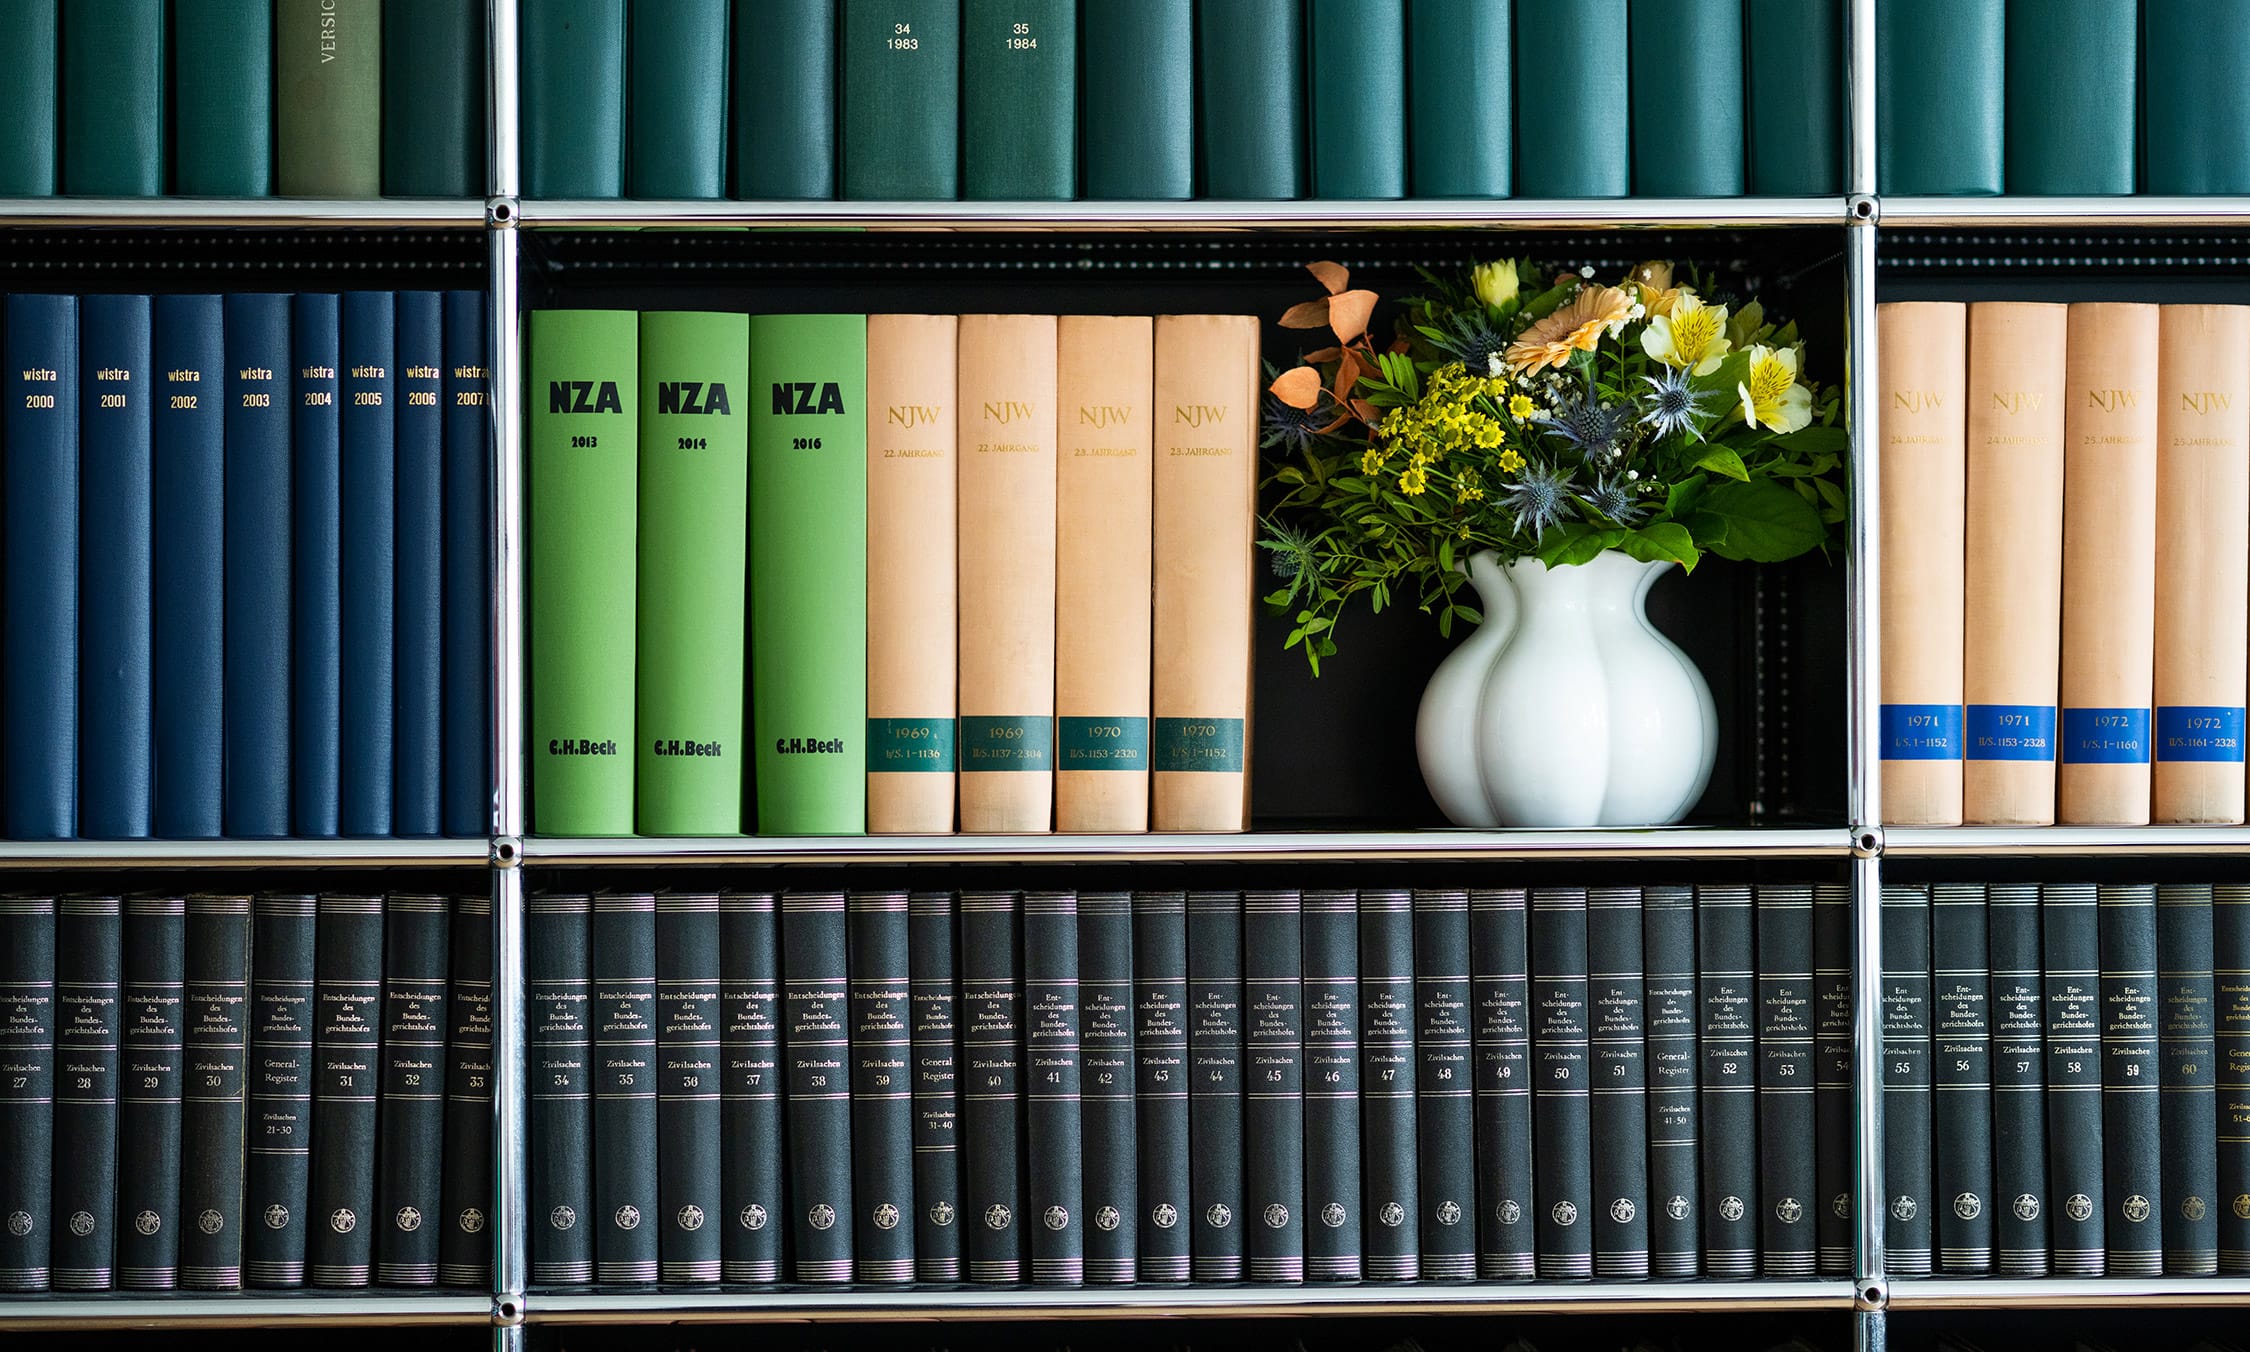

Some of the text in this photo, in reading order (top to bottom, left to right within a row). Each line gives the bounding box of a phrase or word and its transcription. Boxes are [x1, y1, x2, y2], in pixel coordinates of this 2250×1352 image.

[895, 24, 910, 34] 34
[1013, 24, 1029, 34] 35
[887, 39, 918, 49] 1983
[1006, 38, 1037, 49] 1984
[23, 368, 57, 381] wistra
[97, 368, 130, 380] wistra
[168, 369, 200, 382] wistra
[240, 367, 272, 380] wistra
[303, 366, 334, 379] wistra
[352, 366, 385, 378] wistra
[406, 366, 439, 378] wistra
[455, 365, 487, 378] wistra
[26, 395, 54, 408] 2000
[101, 395, 126, 407] 2001
[171, 396, 197, 409] 2002
[242, 394, 270, 408] 2003
[305, 393, 331, 405] 2004
[355, 393, 382, 405] 2005
[409, 393, 436, 405] 2006
[457, 392, 483, 405] 2007
[550, 381, 623, 413] NZA
[658, 382, 731, 415] NZA
[772, 383, 845, 415] NZA
[2089, 390, 2140, 415] NJW
[1894, 391, 1944, 415] NJW
[1993, 391, 2042, 415] NJW
[2182, 392, 2232, 415] NJW
[888, 405, 941, 428] NJW
[984, 402, 1035, 424] NJW
[1079, 405, 1132, 428] NJW
[1175, 405, 1227, 428] NJW
[572, 436, 597, 448] 2013
[678, 438, 707, 450] 2014
[793, 438, 822, 450] 2016
[1185, 448, 1232, 456] JAHRGANG
[1907, 716, 1938, 727] 1971
[1999, 715, 2029, 726] 1971
[2095, 716, 2129, 727] 1972
[2187, 718, 2221, 728] 1972
[896, 727, 929, 739] 1969
[989, 727, 1024, 739] 1969
[1088, 727, 1121, 738] 1970
[1183, 726, 1216, 736] 1970
[549, 739, 617, 755] C.H.Beck
[654, 740, 721, 756] C.H.Beck
[776, 738, 843, 754] C.H.Beck
[323, 994, 375, 1003] Entscheidungen
[660, 992, 716, 1002] Entscheidungen
[682, 1002, 695, 1010] des
[1033, 1003, 1074, 1011] scheidungen
[325, 1025, 370, 1034] gerichtshofes
[666, 1023, 712, 1033] gerichtshofes
[2052, 1021, 2095, 1029] gerichtshofes
[2110, 1022, 2152, 1031] gerichtshofes
[1032, 1029, 1075, 1038] gerichtshofes
[1035, 1058, 1073, 1066] Zivilsachen
[1657, 1052, 1690, 1061] General-
[265, 1059, 300, 1068] General-
[328, 1062, 366, 1070] Zivilsachen
[668, 1061, 711, 1069] Zivilsachen
[1722, 1063, 1737, 1074] 52
[1895, 1063, 1910, 1073] 55
[1956, 1060, 1969, 1071] 56
[2016, 1062, 2029, 1073] 57
[2068, 1062, 2082, 1073] 58
[2182, 1064, 2197, 1074] 60
[1154, 1071, 1168, 1081] 43
[1209, 1071, 1223, 1081] 44
[1267, 1071, 1281, 1081] 45
[1325, 1071, 1340, 1081] 46
[1381, 1070, 1395, 1081] 47
[1437, 1068, 1452, 1079] 48
[1496, 1068, 1510, 1078] 49
[1554, 1068, 1569, 1079] 50
[1613, 1065, 1626, 1076] 51
[1658, 1066, 1689, 1076] Register
[1780, 1065, 1794, 1076] 53
[2127, 1065, 2139, 1076] 59
[206, 1076, 221, 1086] 30
[265, 1073, 297, 1084] Register
[340, 1076, 353, 1086] 31
[405, 1075, 420, 1085] 32
[469, 1077, 483, 1087] 33
[554, 1075, 569, 1085] 34
[619, 1074, 633, 1084] 35
[684, 1076, 698, 1087] 36
[747, 1075, 760, 1085] 37
[812, 1076, 826, 1086] 38
[875, 1076, 890, 1086] 39
[923, 1071, 954, 1082] Register
[987, 1076, 1001, 1086] 40
[1047, 1072, 1060, 1083] 41
[1097, 1073, 1113, 1084] 42
[14, 1078, 27, 1088] 27
[77, 1078, 91, 1089] 28
[144, 1078, 158, 1088] 29
[267, 1126, 291, 1134] 21-30
